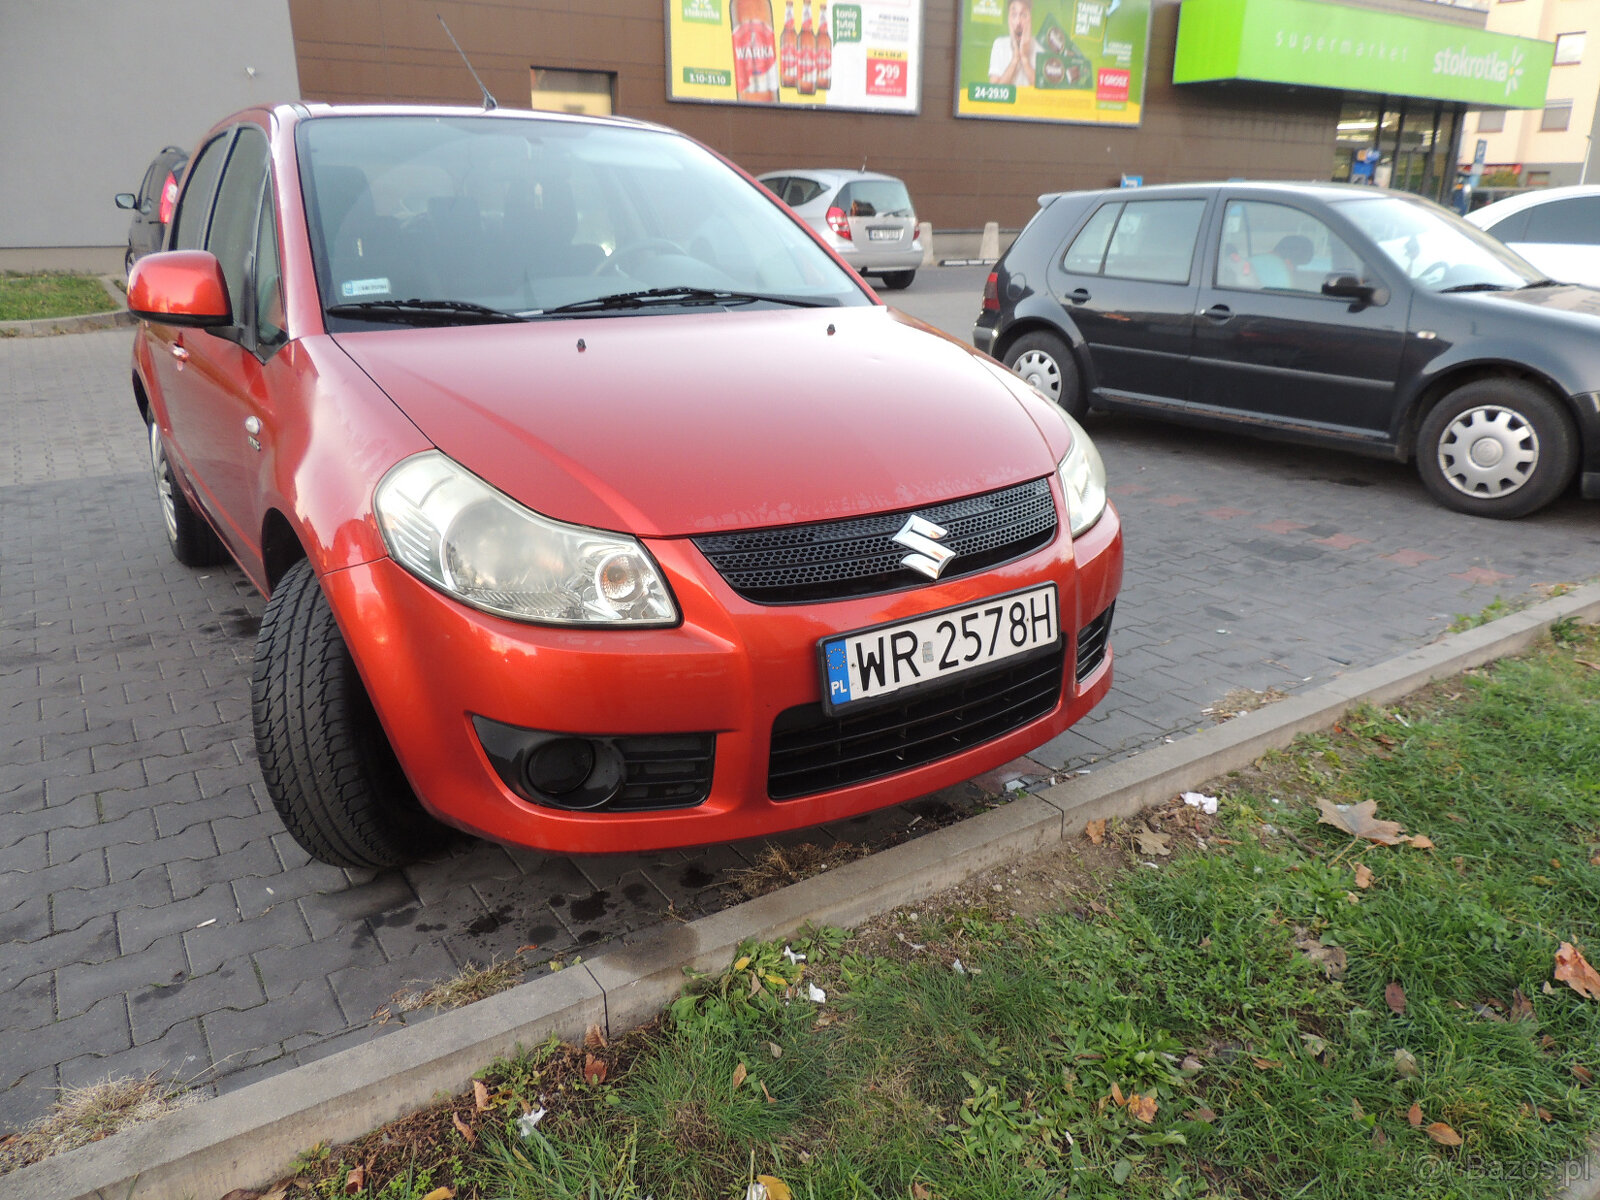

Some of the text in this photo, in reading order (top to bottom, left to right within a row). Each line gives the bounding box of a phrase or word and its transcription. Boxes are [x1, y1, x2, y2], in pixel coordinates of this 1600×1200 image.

[735, 46, 775, 60] WARKA
[1275, 30, 1508, 83] supermarket stokrotka
[974, 86, 1010, 100] 24-29.10
[831, 593, 1052, 695] PL WR 2578H
